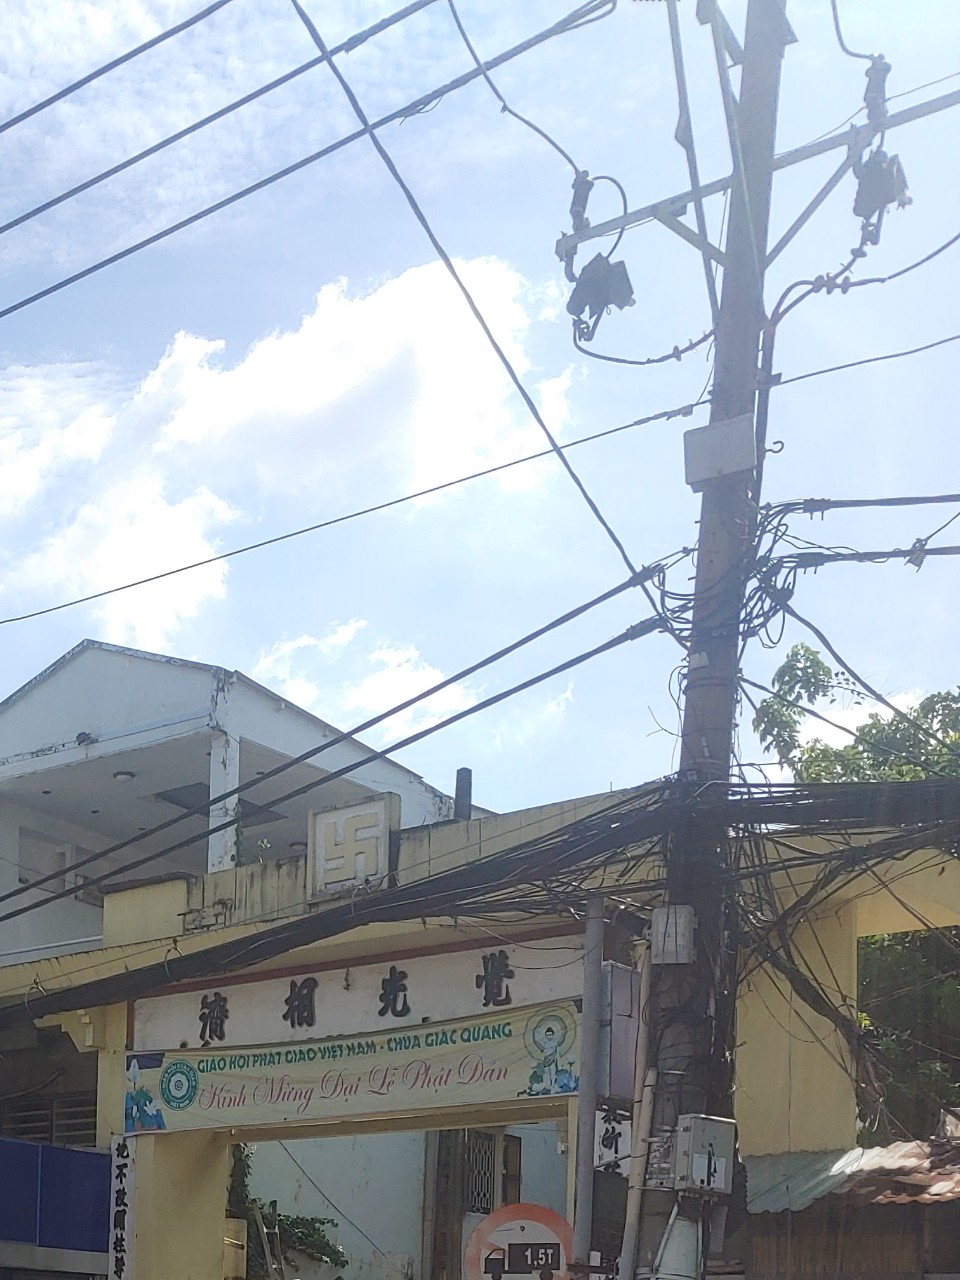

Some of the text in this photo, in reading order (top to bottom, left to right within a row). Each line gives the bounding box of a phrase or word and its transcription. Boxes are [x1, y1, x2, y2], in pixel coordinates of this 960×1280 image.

[198, 1021, 512, 1074] GIÁO HỘI PHẬT GIÁO VIỆT NAM CHÙA GIÁC QUANG
[198, 1081, 247, 1111] Kính
[252, 1072, 314, 1115] Mừng
[319, 1068, 360, 1103] Đại
[367, 1061, 397, 1097] Lễ
[401, 1057, 453, 1095] Phật
[524, 1247, 554, 1268] 1,5T
